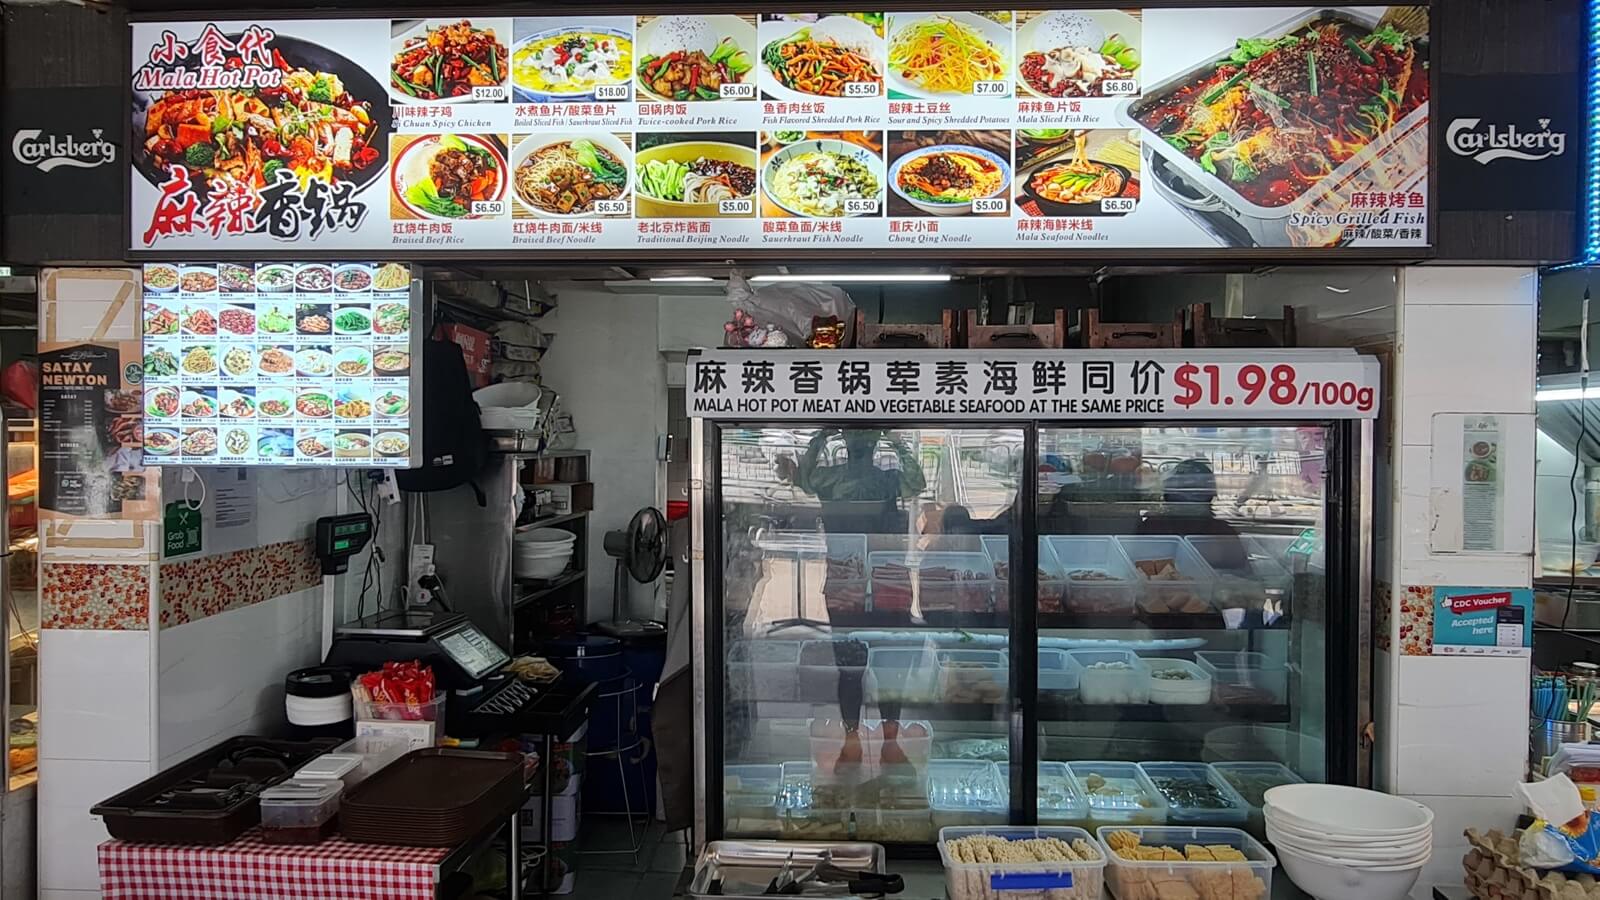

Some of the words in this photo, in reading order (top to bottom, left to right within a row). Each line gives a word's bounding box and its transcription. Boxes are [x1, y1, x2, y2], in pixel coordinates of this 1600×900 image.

[151, 25, 274, 66] 小食代
[139, 66, 197, 88] Mala
[199, 66, 242, 88] Hot
[243, 66, 280, 87] Pot
[598, 87, 626, 97] $18.00
[723, 86, 750, 96] $6.00
[849, 84, 876, 95] $5.50
[976, 83, 1004, 94] $7.00
[1105, 82, 1134, 92] $6.80
[475, 88, 503, 98] $12.00
[516, 104, 616, 116] 水煮鱼片/酸菜鱼片
[638, 104, 688, 115] 回锅肉饭
[763, 102, 825, 114] 鱼香肉丝饭
[888, 102, 950, 114] 酸辣土豆丝
[1018, 101, 1081, 113] 麻辣鱼片饭
[432, 120, 456, 128] Spicy
[552, 118, 564, 126] Fish
[638, 117, 695, 125] Twice-cooked
[697, 117, 716, 125] Pork
[762, 116, 778, 124] Fish
[779, 116, 810, 124] Flavored
[812, 116, 845, 124] Shredded
[846, 116, 863, 124] Pork
[864, 116, 880, 124] Rice
[888, 116, 905, 124] Sour
[906, 116, 920, 124] and
[921, 116, 942, 125] Spicy
[943, 116, 978, 124] Shredded
[979, 116, 1010, 124] Potatoes
[1446, 118, 1566, 158] Carlsberg
[12, 129, 116, 166] Carlsberg
[976, 200, 1003, 211] $5.00
[1104, 200, 1132, 210] $6.50
[1351, 192, 1424, 208] 麻辣烤鱼
[143, 166, 367, 246] 麻辣香锅
[475, 203, 501, 213] $6.50
[598, 202, 625, 212] $6.50
[722, 202, 749, 212] $5.00
[848, 201, 875, 211] $6.50
[1290, 212, 1332, 226] Spicy
[1336, 212, 1389, 225] Grilled
[1393, 212, 1424, 224] Fish
[393, 223, 452, 234] 红烧牛肉饭
[513, 222, 602, 234] 红烧牛肉面/米线
[637, 222, 710, 233] 老北京炸酱面
[762, 221, 842, 233] 酸菜鱼面/米线
[889, 220, 939, 232] 重庆小面
[1017, 219, 1093, 231] 麻辣海鲜米线
[762, 235, 811, 243] Sauerkraut
[813, 235, 832, 243] Fish
[833, 235, 864, 243] Noodle
[888, 234, 915, 243] Chong
[917, 234, 940, 243] Qing
[941, 234, 972, 242] Noodle
[1016, 233, 1038, 241] Mala
[1040, 233, 1074, 241] Seafood
[1075, 233, 1109, 241] Noodles
[1343, 228, 1422, 239] 麻辣/酸菜/香辣
[392, 236, 424, 244] Braised
[425, 236, 445, 244] Beef
[446, 236, 464, 244] Rice
[512, 236, 544, 244] Braised
[545, 236, 565, 244] Beef
[566, 236, 596, 244] Noodle
[686, 235, 718, 244] Beijing
[719, 235, 750, 243] Noodle
[42, 362, 92, 373] SATAY
[42, 374, 108, 385] NEWTON
[694, 360, 1166, 395] 麻辣香锅荤素海鲜同价
[1174, 361, 1374, 412] $1.98/100g
[694, 398, 733, 412] MALA
[737, 398, 768, 412] HOT
[771, 399, 798, 412] POT
[802, 399, 841, 412] MEAT
[844, 399, 875, 412] AND
[880, 399, 955, 413] VEGETABLE
[959, 399, 1025, 413] SEAFOOD
[1029, 400, 1047, 413] AT
[1052, 400, 1077, 413] THE
[1081, 400, 1122, 413] SAME
[1126, 400, 1164, 413] PRICE
[167, 531, 184, 540] Grab
[167, 541, 184, 550] Food
[1454, 600, 1471, 608] CDC
[1473, 597, 1506, 606] Voucher
[1452, 616, 1494, 628] Accepted
[1472, 627, 1494, 635] here
